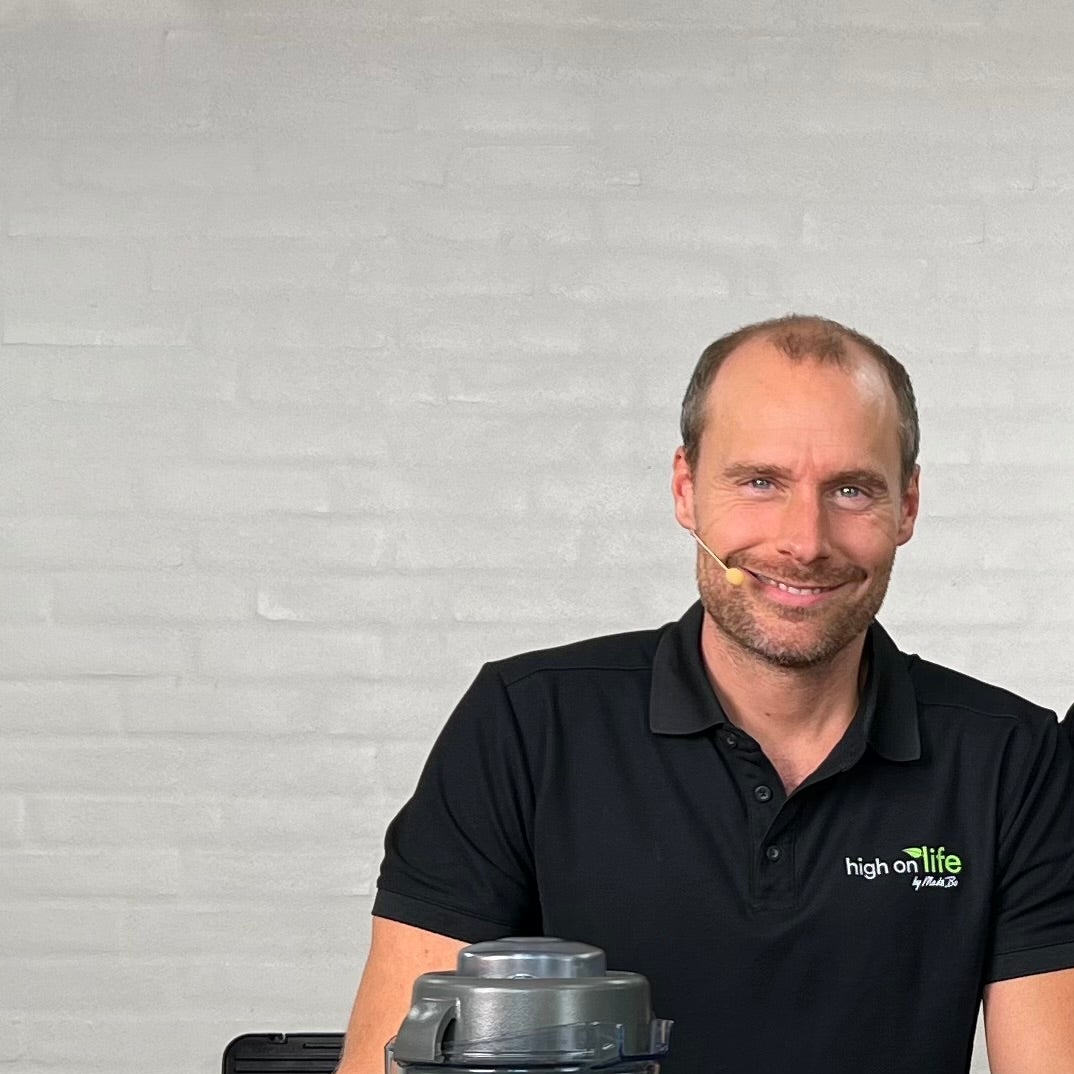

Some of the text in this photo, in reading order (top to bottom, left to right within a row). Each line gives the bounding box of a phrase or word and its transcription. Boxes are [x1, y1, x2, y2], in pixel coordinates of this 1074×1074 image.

[845, 845, 962, 880] high on life
[911, 876, 921, 891] by
